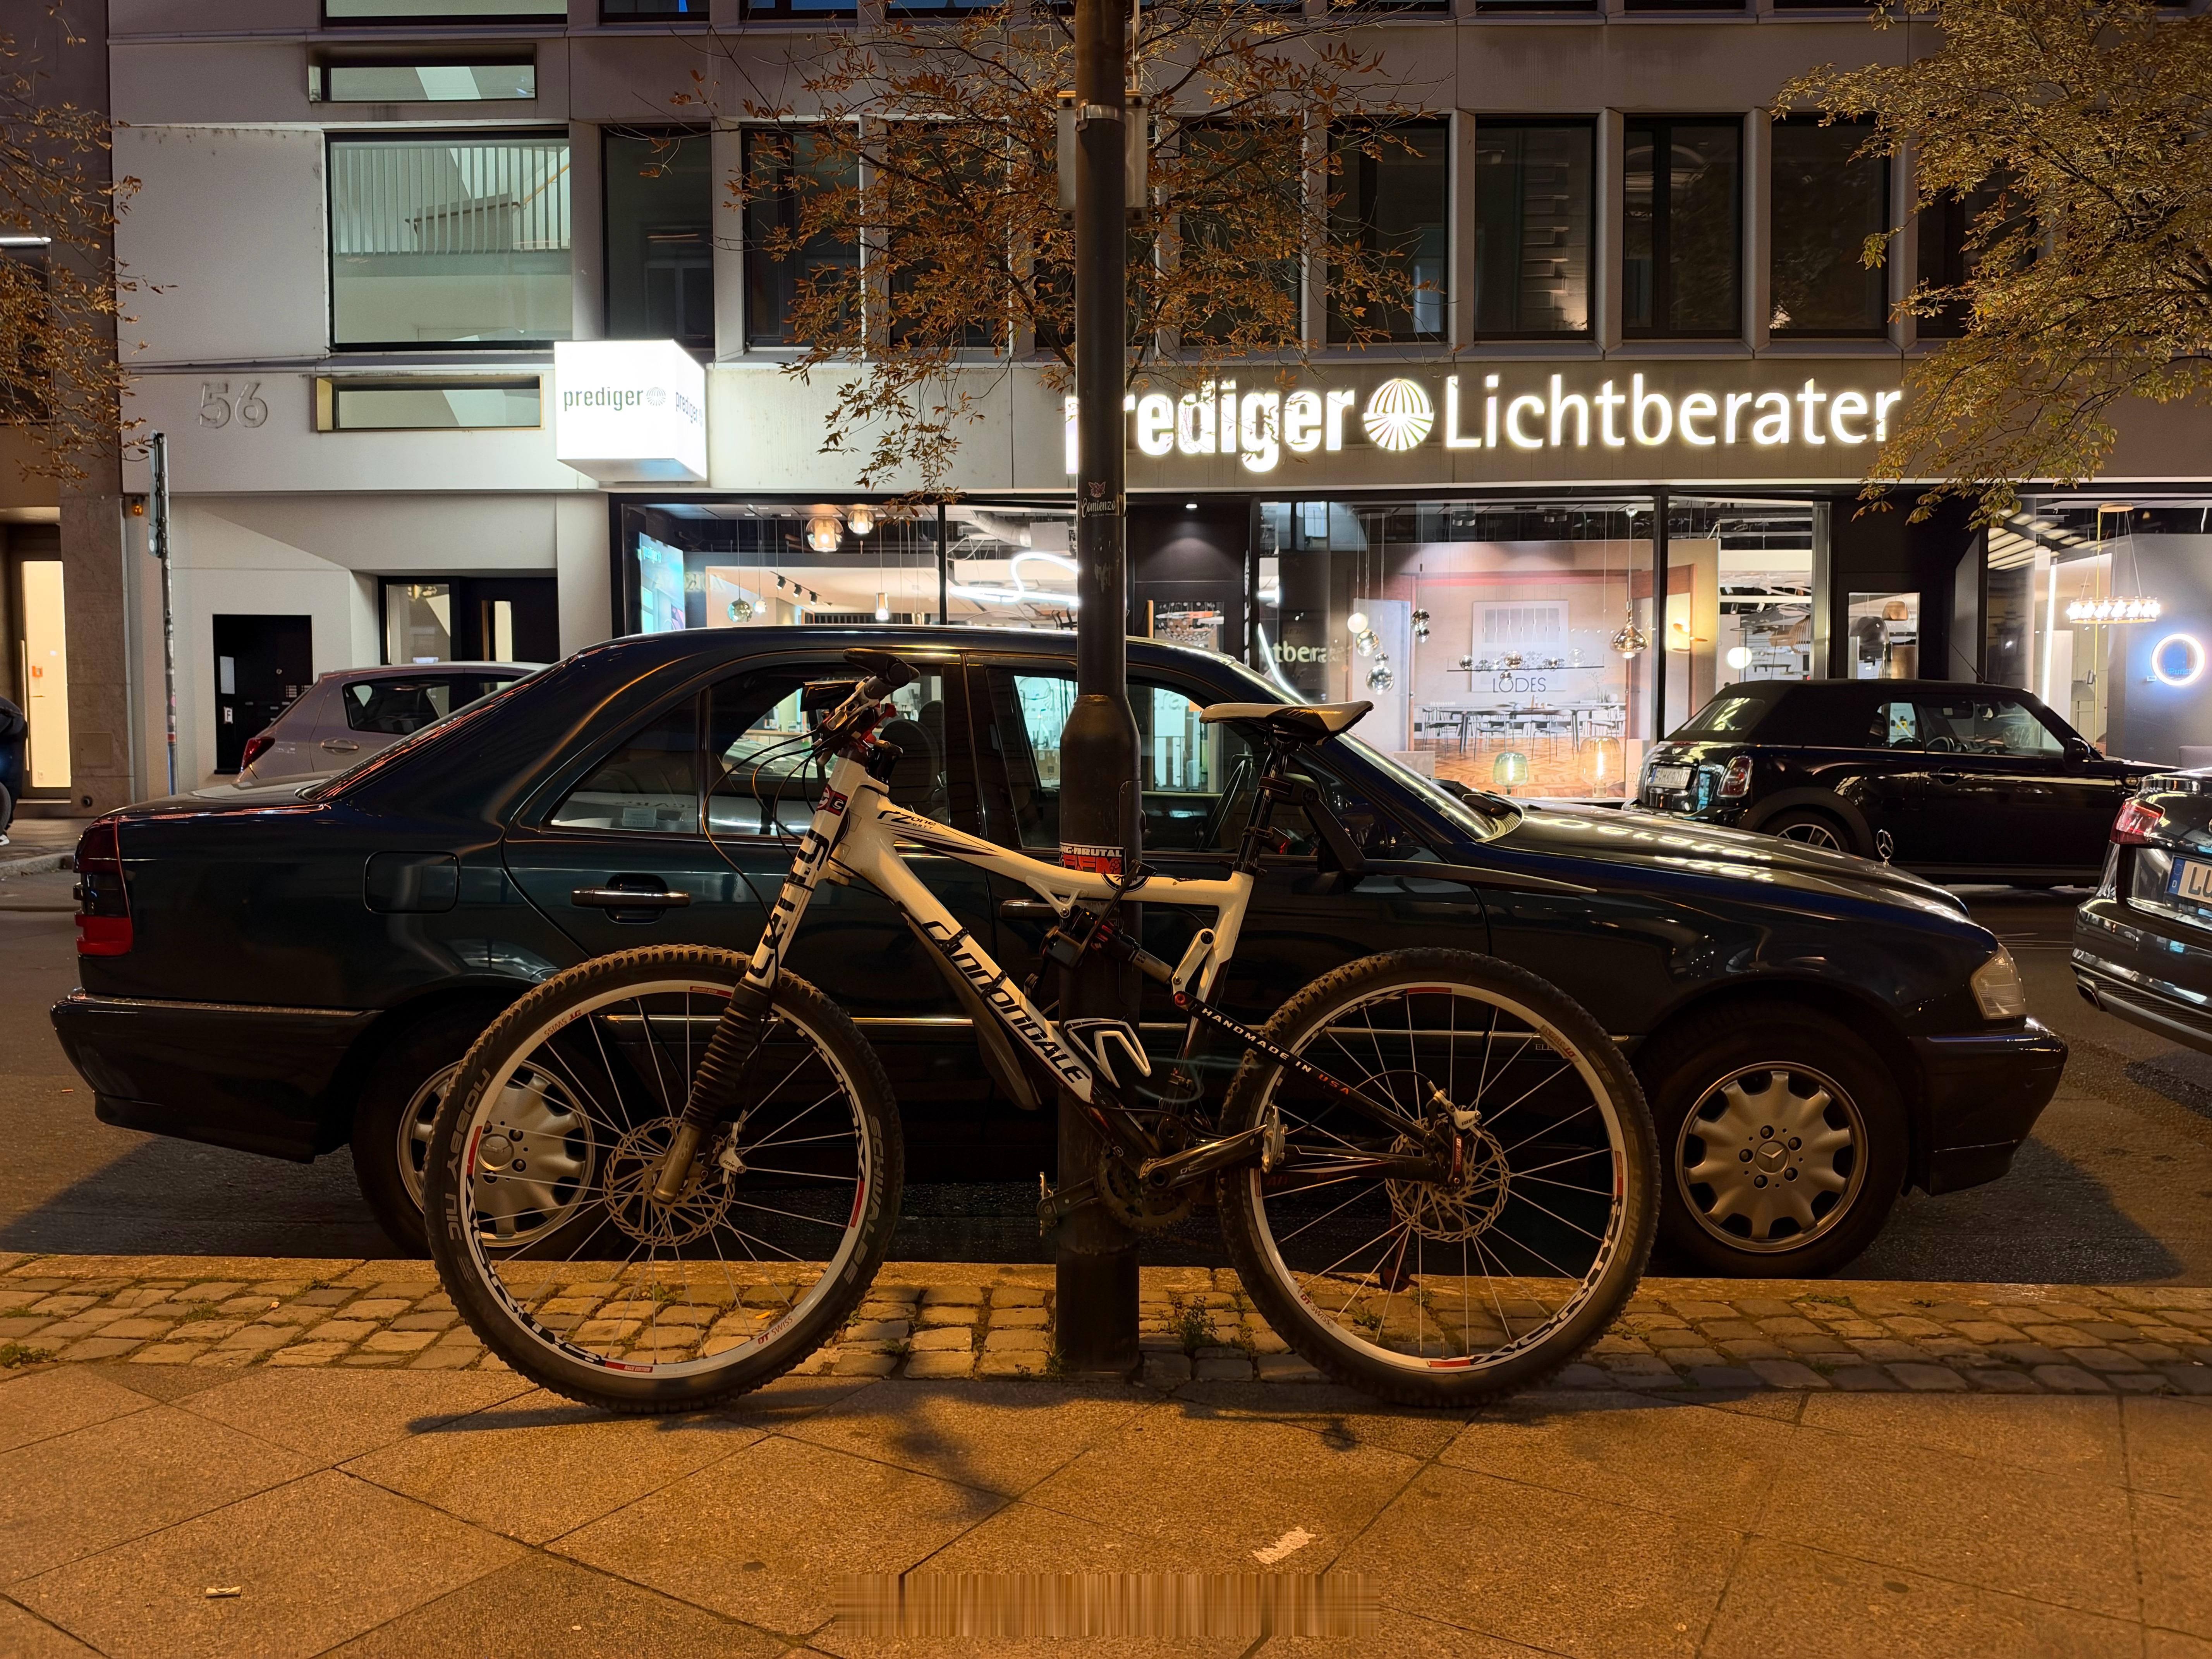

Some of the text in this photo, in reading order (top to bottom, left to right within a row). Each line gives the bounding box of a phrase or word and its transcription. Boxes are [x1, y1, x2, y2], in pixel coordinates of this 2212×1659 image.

[200, 383, 268, 428] 56
[564, 386, 643, 411] prediger
[675, 391, 697, 424] prediger
[1446, 373, 1902, 448] Lichtberater
[1493, 677, 1546, 692] LODES
[1202, 1008, 1350, 1095] HANDMADE IN USA
[844, 1114, 884, 1285] SCHWALBE
[1300, 1293, 1332, 1325] DT SWISS
[757, 1316, 793, 1345] DT SWISS
